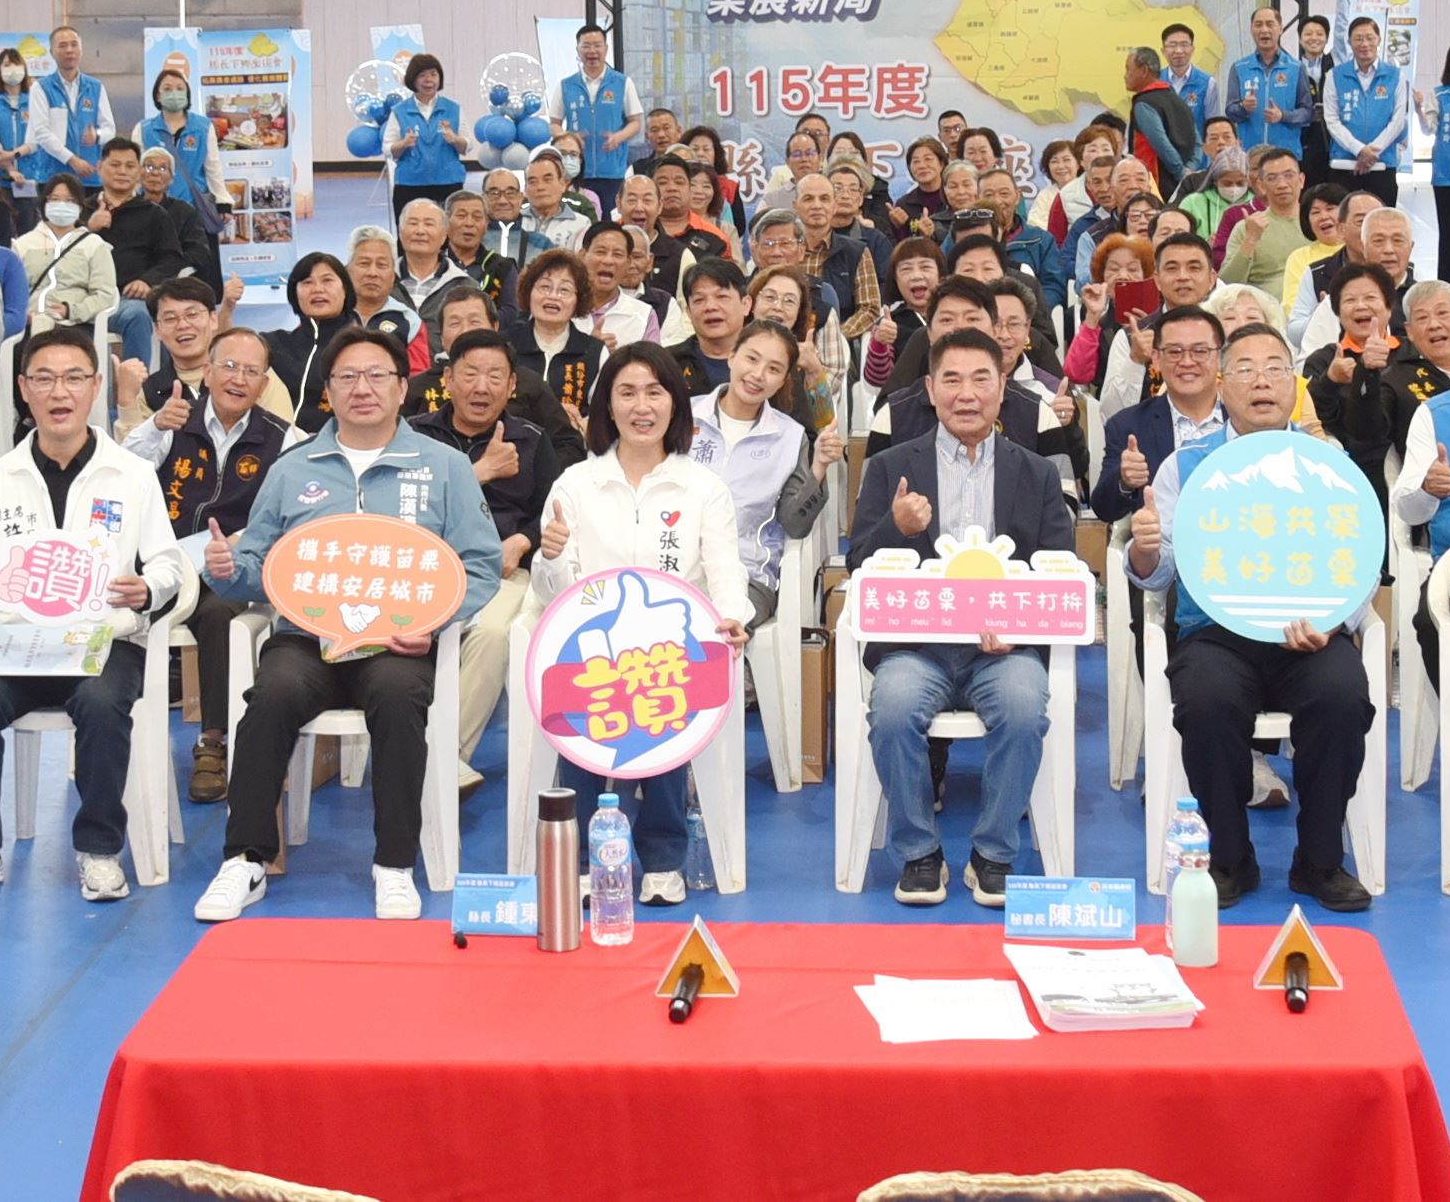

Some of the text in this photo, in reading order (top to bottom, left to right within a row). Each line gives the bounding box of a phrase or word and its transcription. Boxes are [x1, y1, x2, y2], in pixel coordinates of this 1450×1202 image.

[713, 64, 927, 115] 115年度
[296, 538, 440, 572] 攜手守護苗栗
[1201, 545, 1359, 588] 美好苗栗
[292, 571, 437, 605] 建構安居城市
[572, 640, 692, 741] 讚
